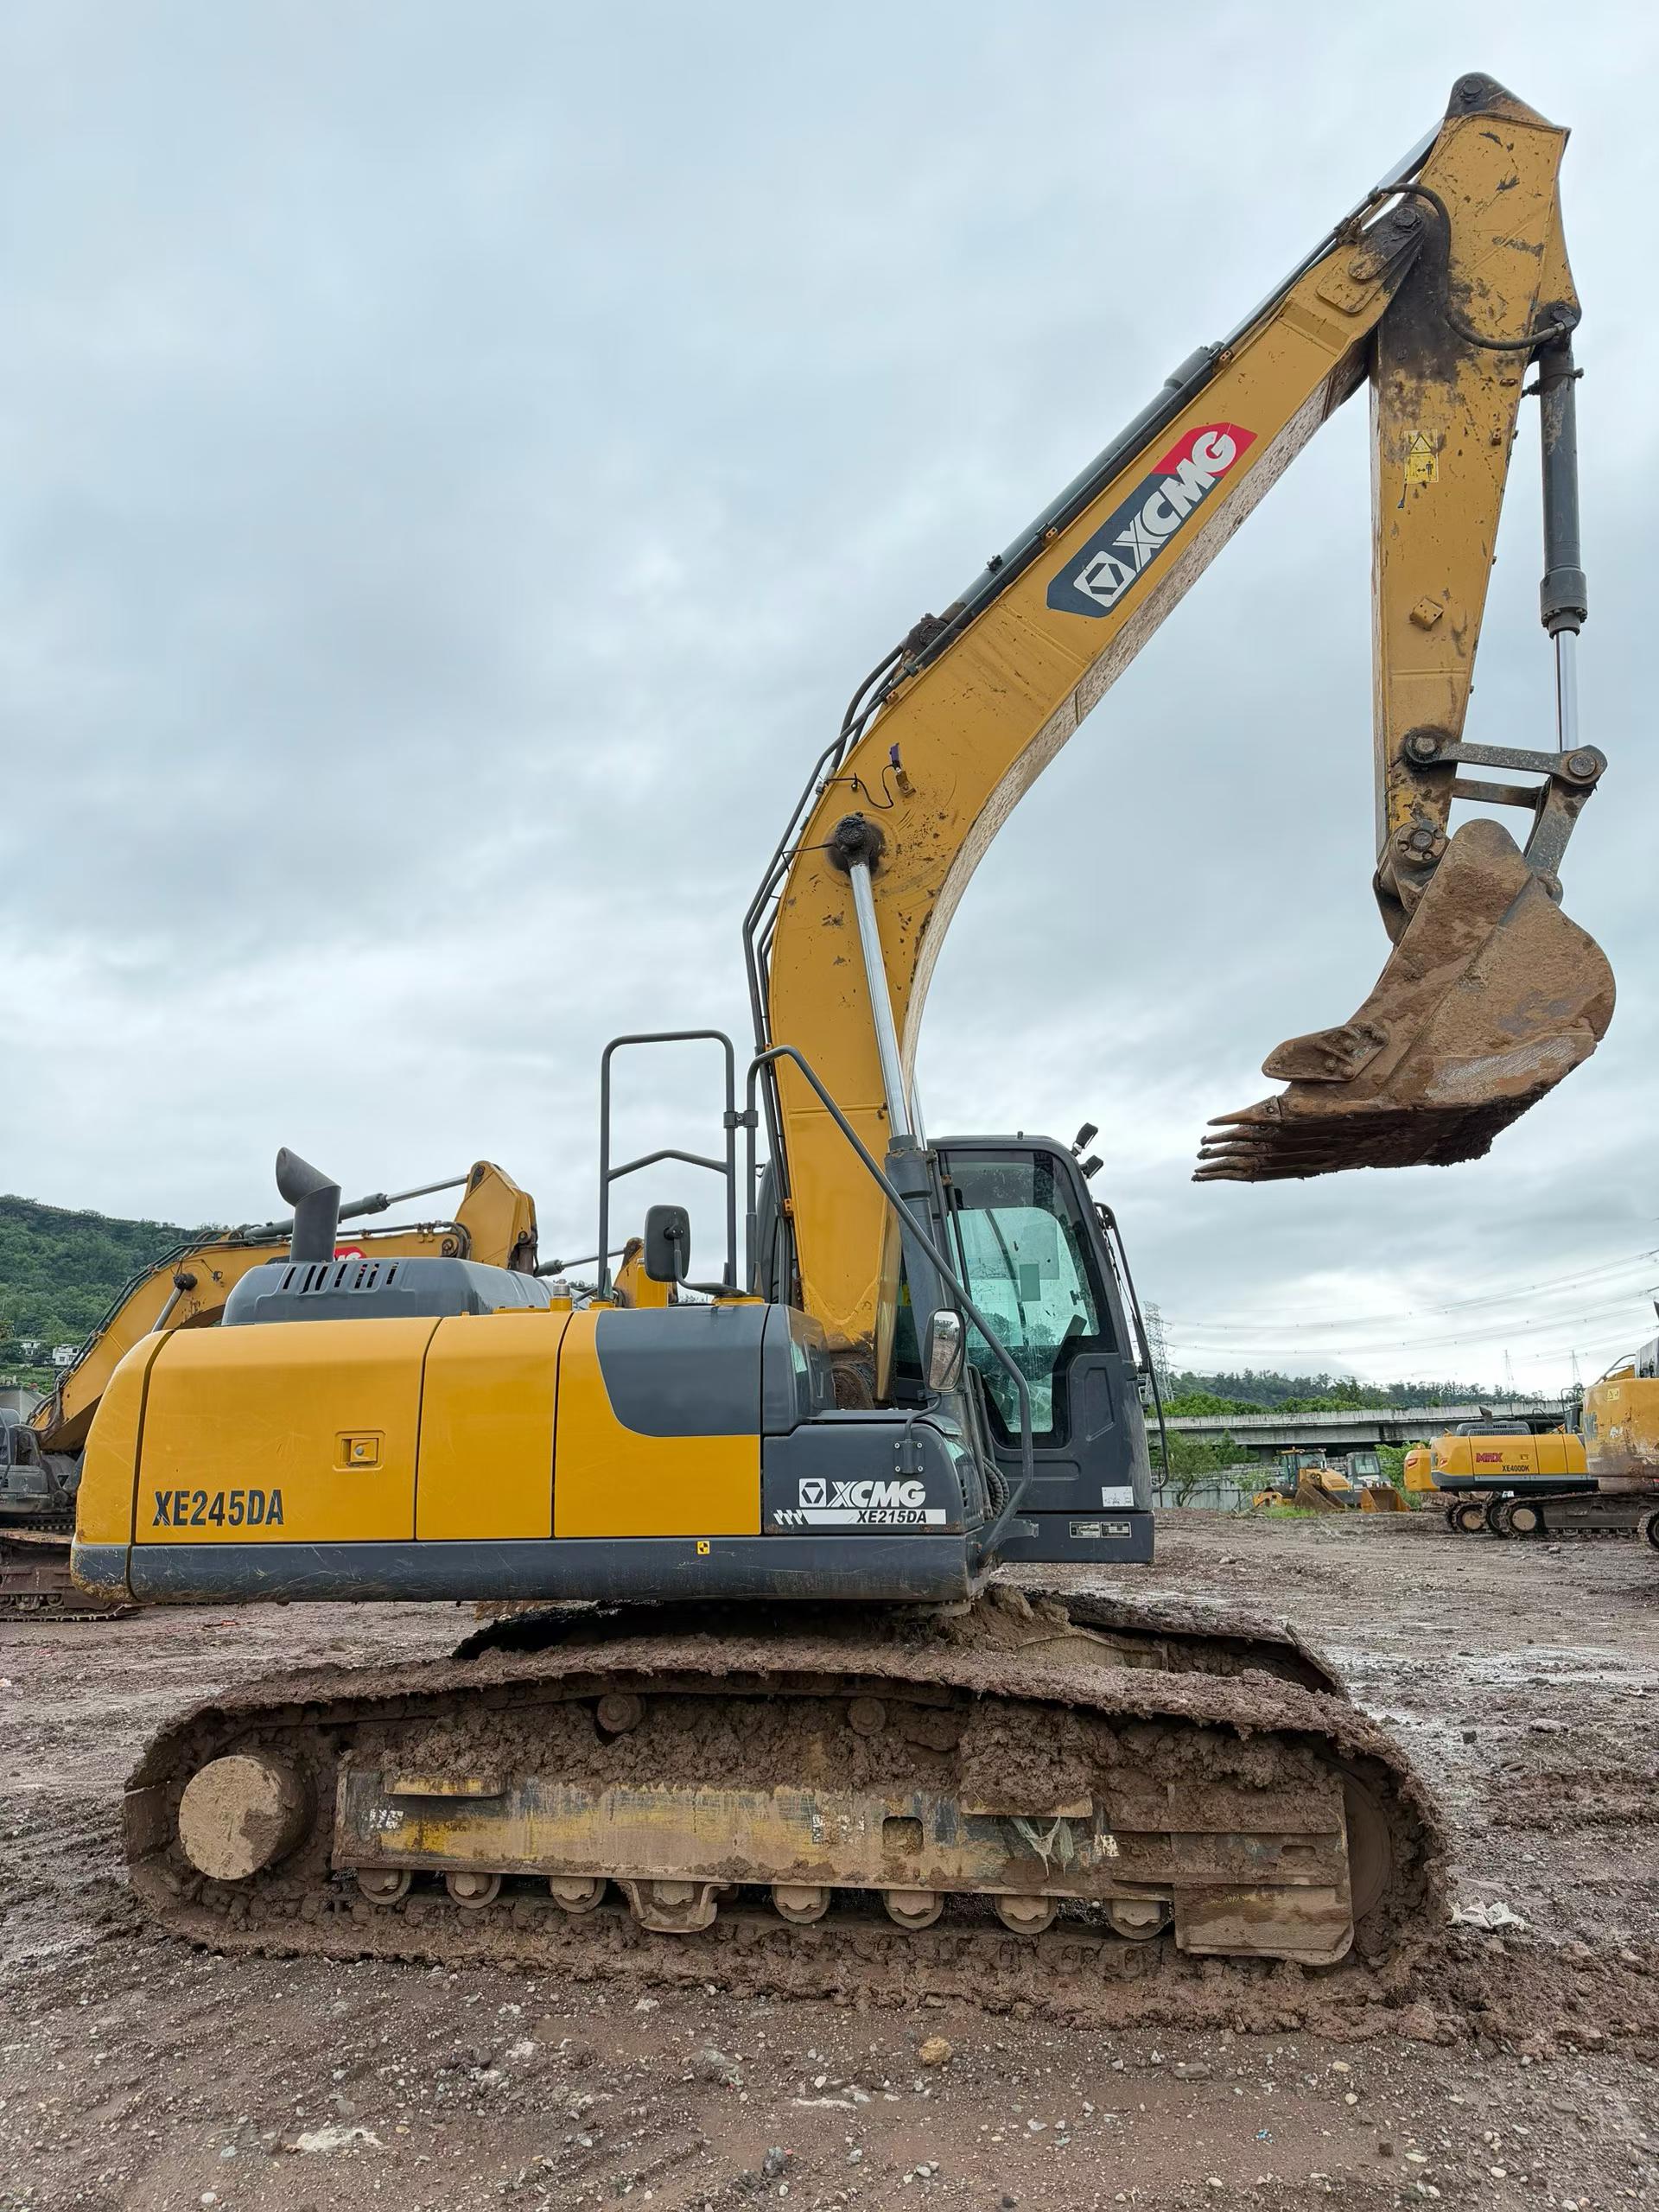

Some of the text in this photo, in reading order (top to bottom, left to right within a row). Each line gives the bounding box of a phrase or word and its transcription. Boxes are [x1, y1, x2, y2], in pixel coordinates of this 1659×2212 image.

[1112, 431, 1236, 573] XCMG
[152, 1490, 284, 1526] XE245DA
[827, 1480, 926, 1508] XCMG
[857, 1510, 927, 1523] XE215DA
